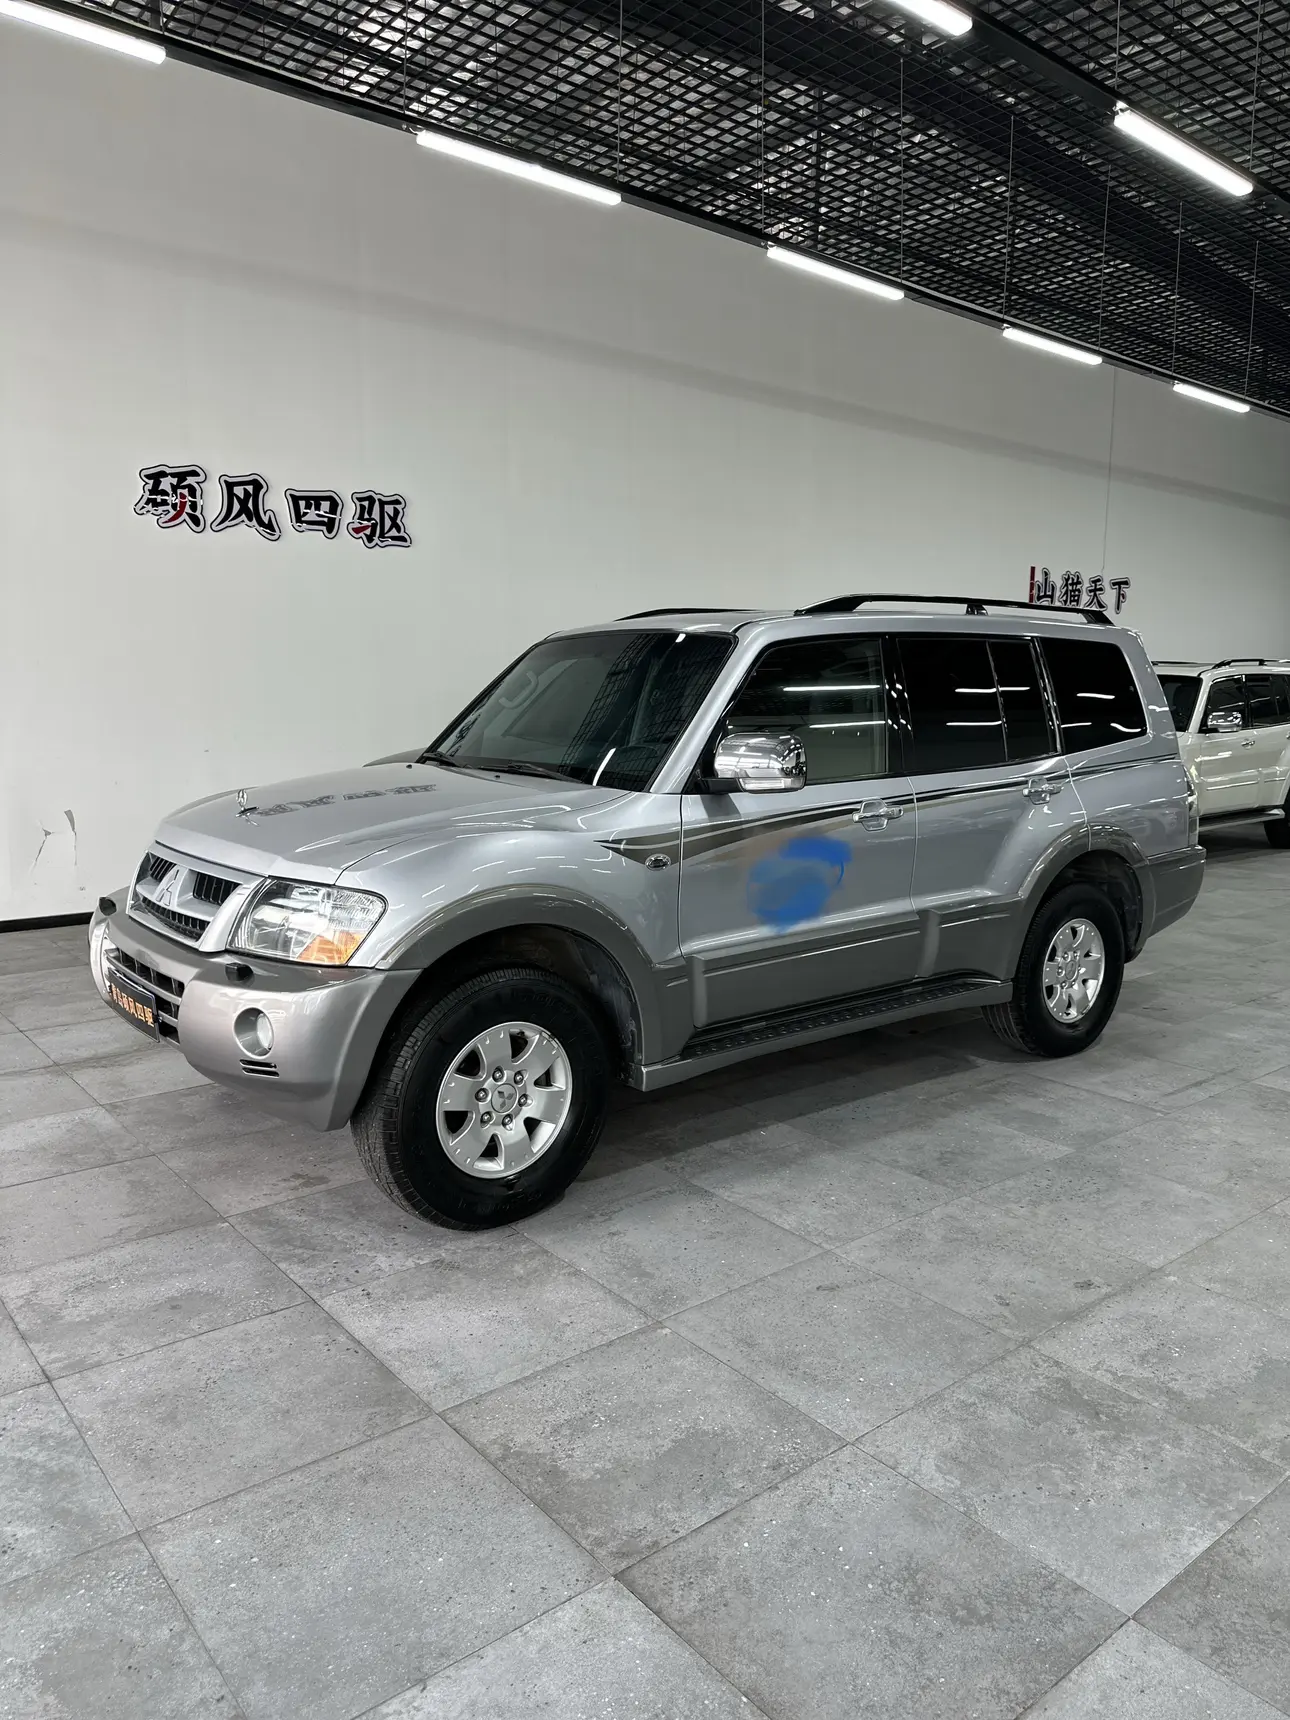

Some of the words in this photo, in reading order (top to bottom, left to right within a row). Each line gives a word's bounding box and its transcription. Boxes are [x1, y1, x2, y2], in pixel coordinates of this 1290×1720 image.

[134, 465, 411, 548] 硕风四驱
[1035, 567, 1130, 614] 山猫天下
